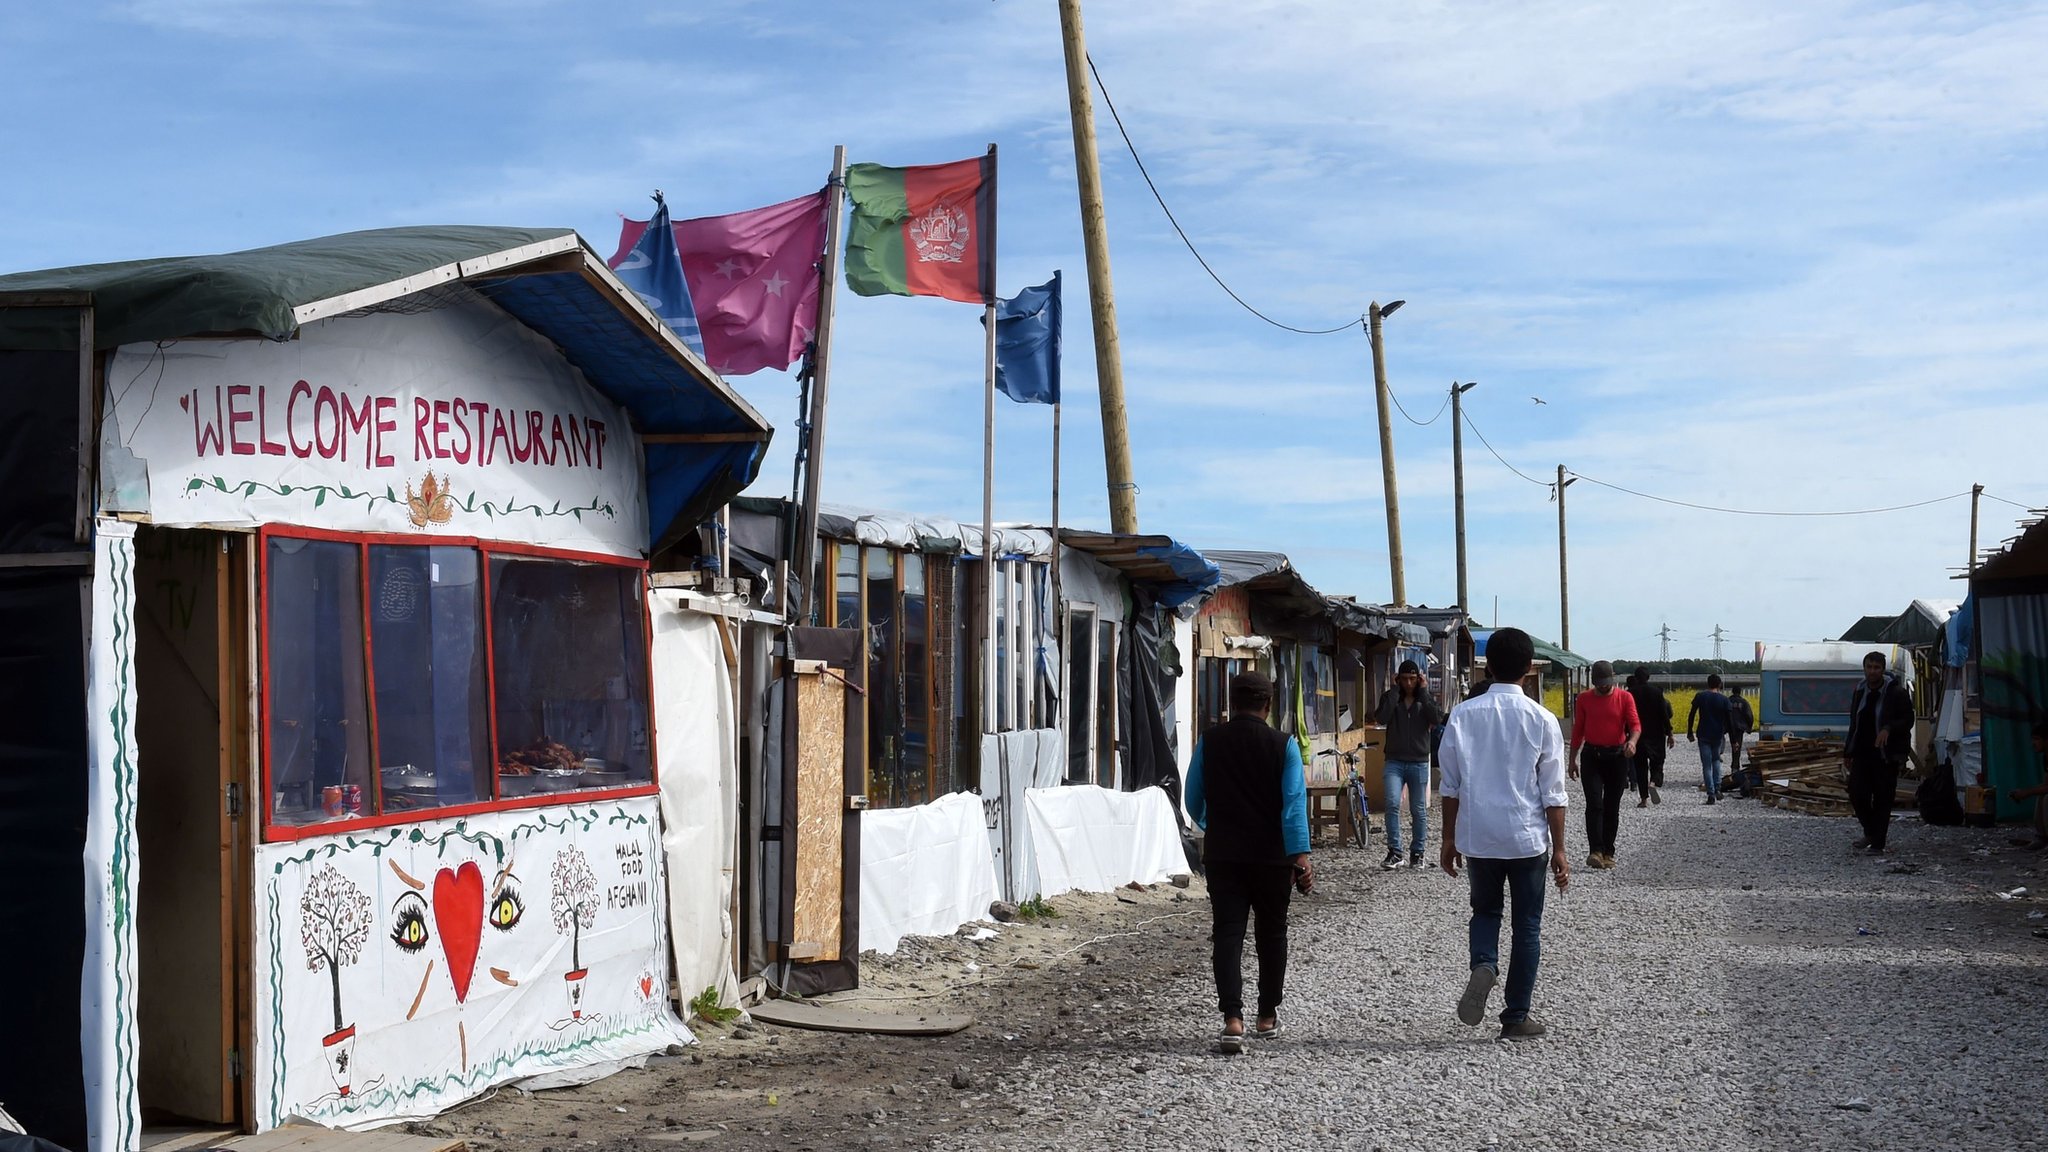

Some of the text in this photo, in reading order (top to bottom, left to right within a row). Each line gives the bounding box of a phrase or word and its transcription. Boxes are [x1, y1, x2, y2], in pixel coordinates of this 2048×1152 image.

[193, 380, 605, 469] WELCOME RESTAURANT
[615, 839, 643, 860] HALAL
[621, 859, 643, 878] FOOD
[607, 881, 647, 910] AFGHANI
